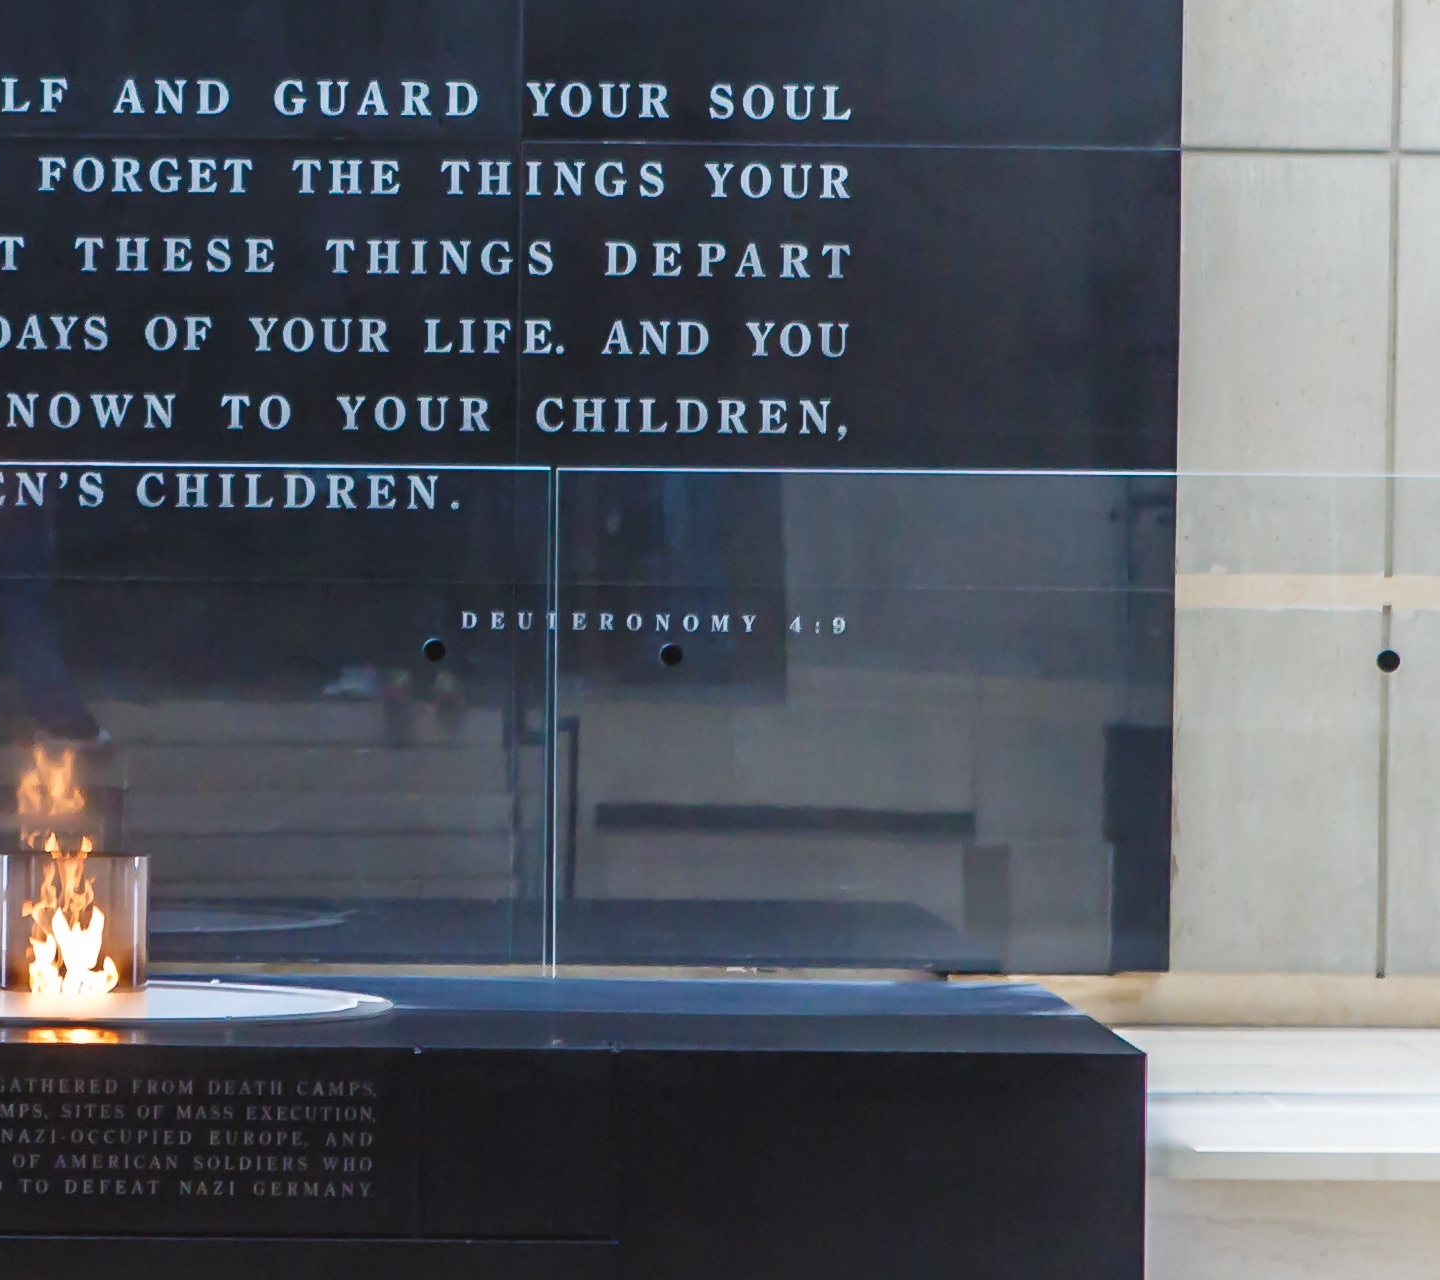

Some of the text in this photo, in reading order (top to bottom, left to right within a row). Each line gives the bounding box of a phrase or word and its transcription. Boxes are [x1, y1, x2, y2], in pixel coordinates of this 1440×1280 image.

[112, 77, 230, 116] AND
[273, 78, 479, 119] GUARD
[525, 80, 670, 119] YOUR
[708, 82, 852, 122] SOUL
[38, 154, 253, 195] FORGET
[291, 157, 401, 196] THE
[440, 158, 665, 198] THINGS
[704, 161, 851, 200] YOUR
[74, 235, 275, 275] THESE
[325, 237, 554, 277] THINGS
[604, 240, 851, 279] DEPART
[144, 314, 213, 353] OF
[248, 315, 390, 355] YOUR
[423, 316, 565, 355] LIFE.
[601, 318, 710, 357] AND
[745, 319, 850, 359] YOU
[220, 393, 292, 431] TO
[335, 393, 490, 434] YOUR
[535, 395, 848, 442] CHILDREN,
[136, 473, 460, 511] CHILDREN.
[461, 610, 848, 636] DEUTERONOMY 4:9
[131, 1077, 194, 1096] FROM
[207, 1078, 283, 1097] DEATH
[60, 1102, 125, 1120] SITES
[136, 1102, 164, 1121] OF
[176, 1103, 234, 1121] MASS
[0, 1126, 193, 1147] NAZI-OCCUPIED
[325, 1130, 374, 1149] AND
[11, 1152, 41, 1169] OF
[53, 1152, 178, 1171] AMERICAN
[193, 1153, 309, 1173] SOLDIERS
[322, 1155, 373, 1173] WHO
[18, 1177, 49, 1196] TO
[64, 1177, 160, 1197] DEFEAT
[179, 1179, 235, 1197] NAZI
